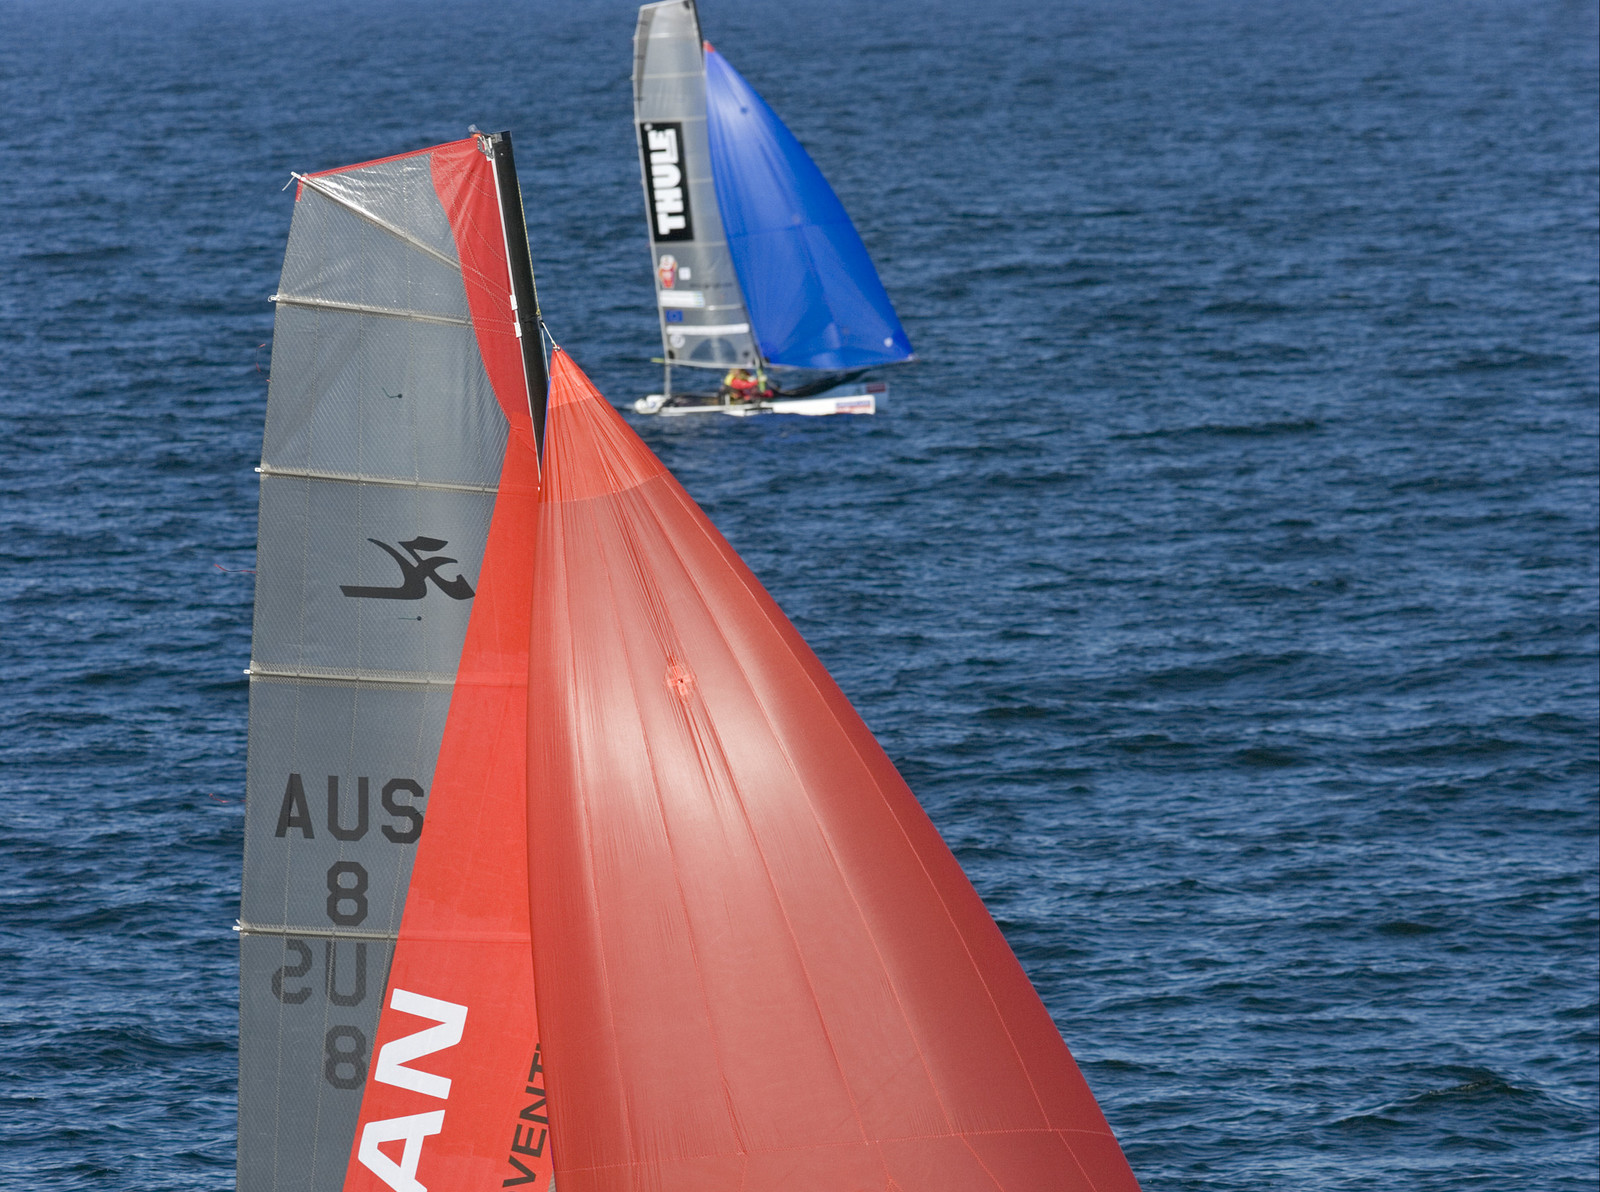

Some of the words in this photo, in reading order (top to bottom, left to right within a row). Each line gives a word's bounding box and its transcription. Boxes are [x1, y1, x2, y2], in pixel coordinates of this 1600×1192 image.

[647, 128, 686, 235] THULE
[274, 772, 425, 844] AUS
[326, 860, 369, 927] 8
